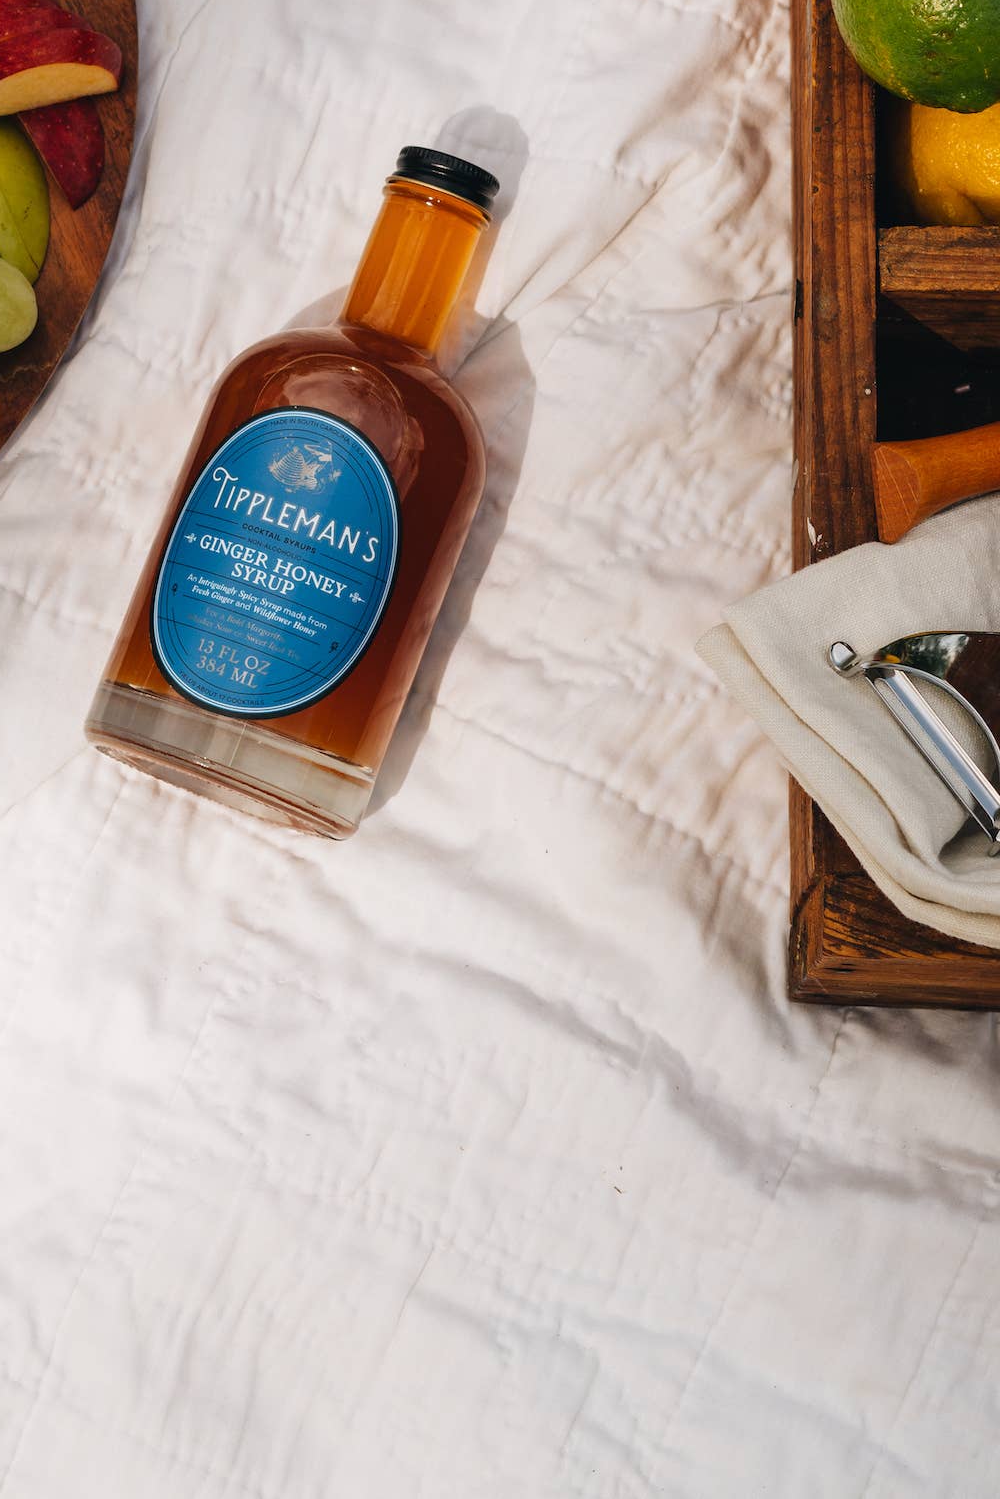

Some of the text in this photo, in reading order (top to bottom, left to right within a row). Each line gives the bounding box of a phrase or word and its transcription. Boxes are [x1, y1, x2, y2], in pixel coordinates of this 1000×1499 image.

[297, 418, 319, 429] SOUTH
[242, 523, 317, 555] COCKTAIL SYRUPS
[199, 534, 348, 599] GINGER HONEY
[231, 562, 296, 596] SYRUP
[186, 573, 328, 631] An Intriguingly Spicy Syrup made from
[191, 584, 318, 638] Fresh Ginger and Wildflower Honey
[196, 655, 259, 689] 384 ML
[198, 638, 271, 676] 13 FL OZ
[197, 684, 218, 698] ABOUT
[226, 695, 265, 706] COCKTAILS
